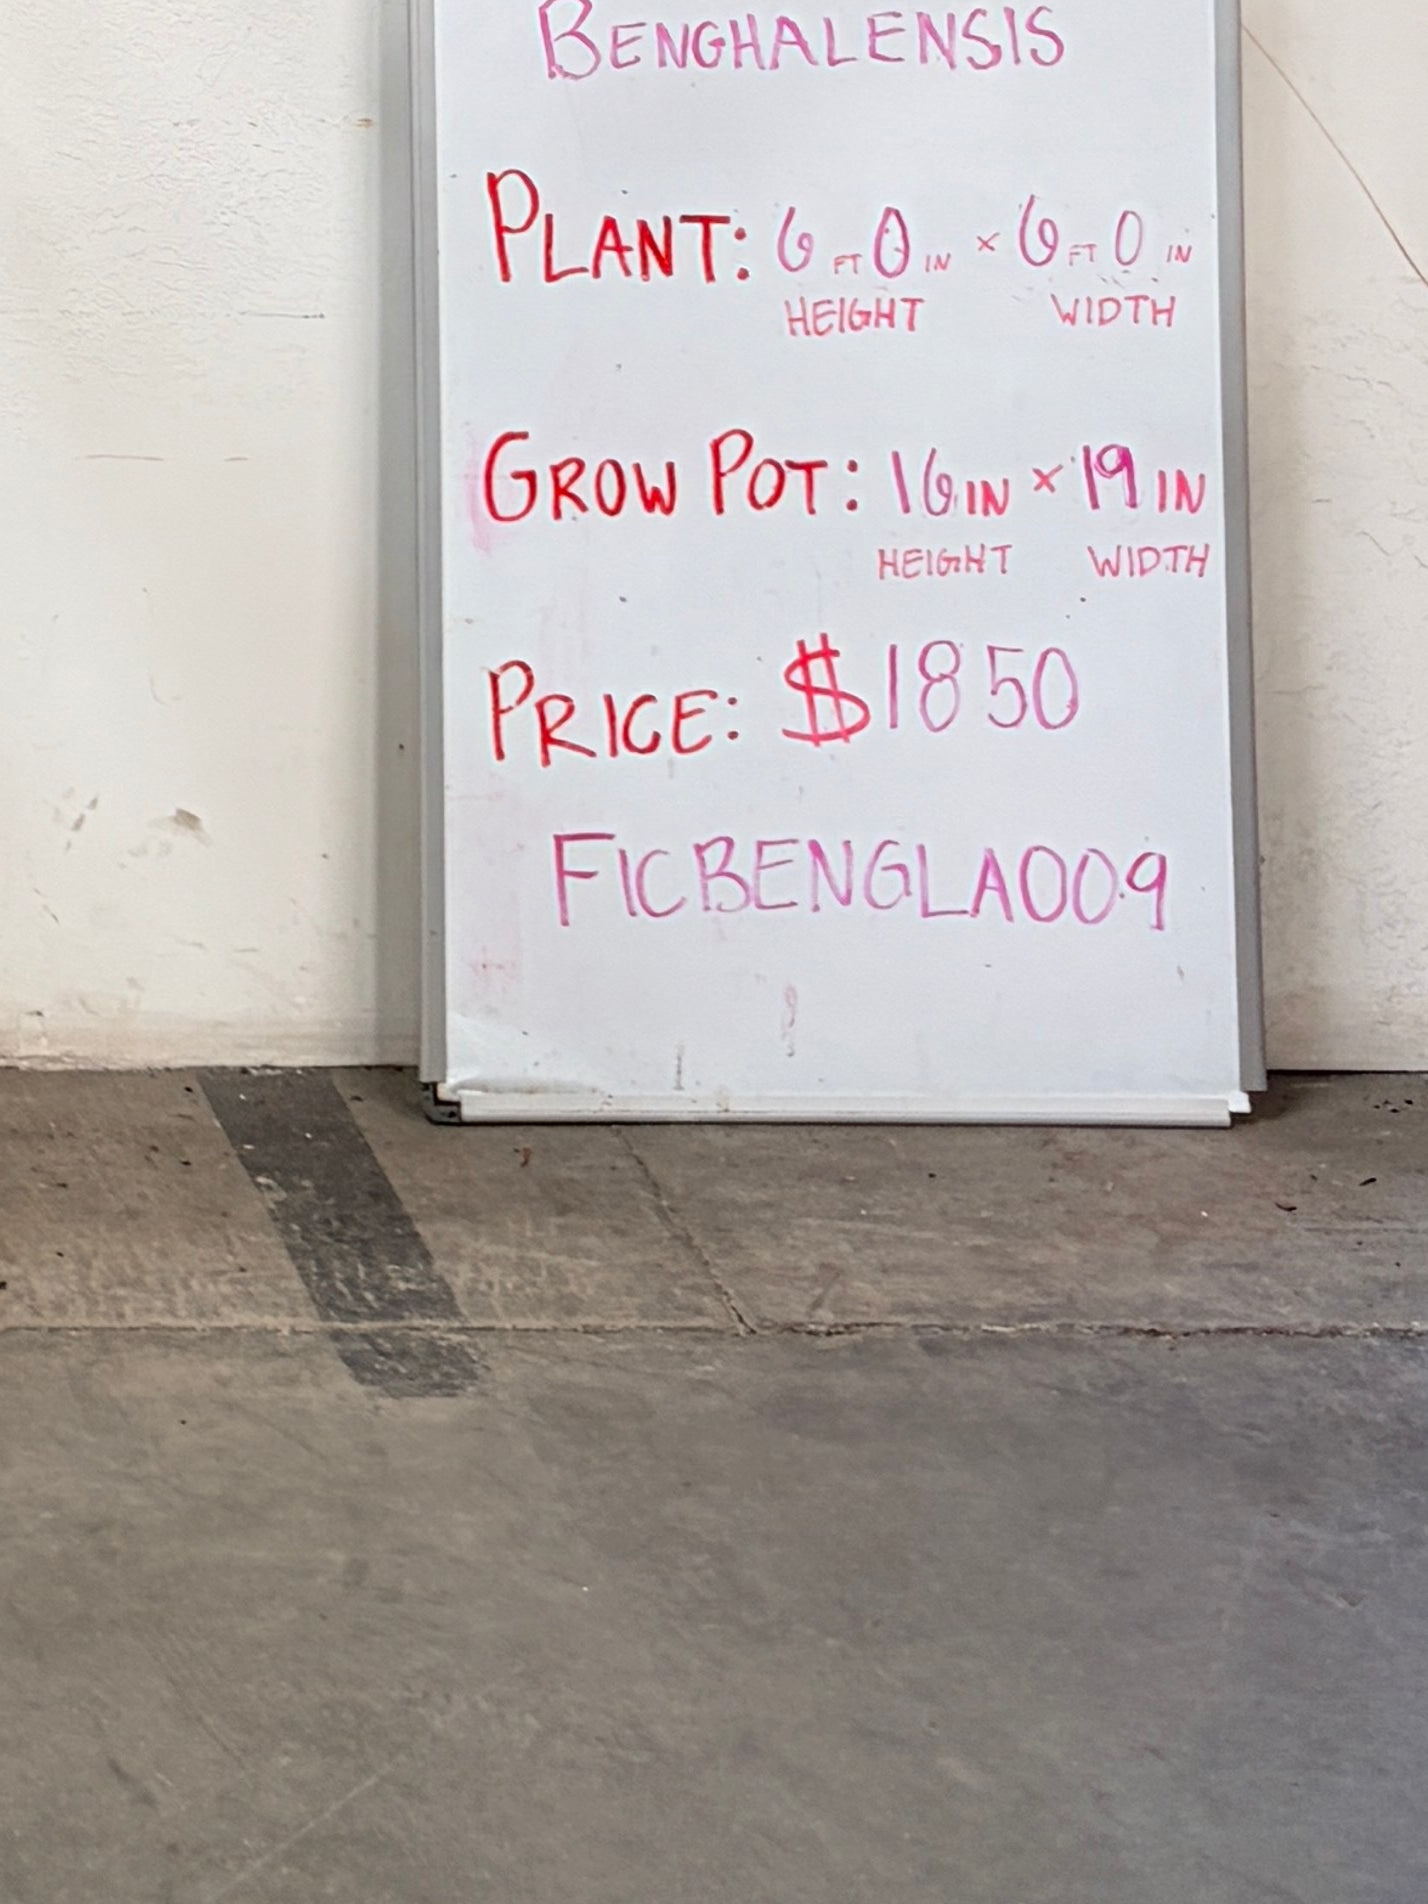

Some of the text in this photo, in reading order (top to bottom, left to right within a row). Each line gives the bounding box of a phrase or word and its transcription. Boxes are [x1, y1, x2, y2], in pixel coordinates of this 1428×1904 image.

[484, 167, 750, 285] PLANT:
[776, 206, 815, 273] 6
[833, 253, 862, 275] FT
[872, 205, 910, 279] 0
[924, 253, 951, 272] IN
[1017, 193, 1059, 267] 6
[1069, 243, 1098, 266] FT
[1114, 209, 1144, 267] 0
[1166, 243, 1193, 263] IN
[784, 293, 1177, 337] HEIGHT WIDTH
[480, 429, 679, 526] GROW
[706, 429, 859, 519] POT:
[877, 542, 1212, 580] HEIGHT WIDTH
[486, 632, 1080, 769] PRICE: $1850
[552, 831, 1168, 932] FICBENGLA009
